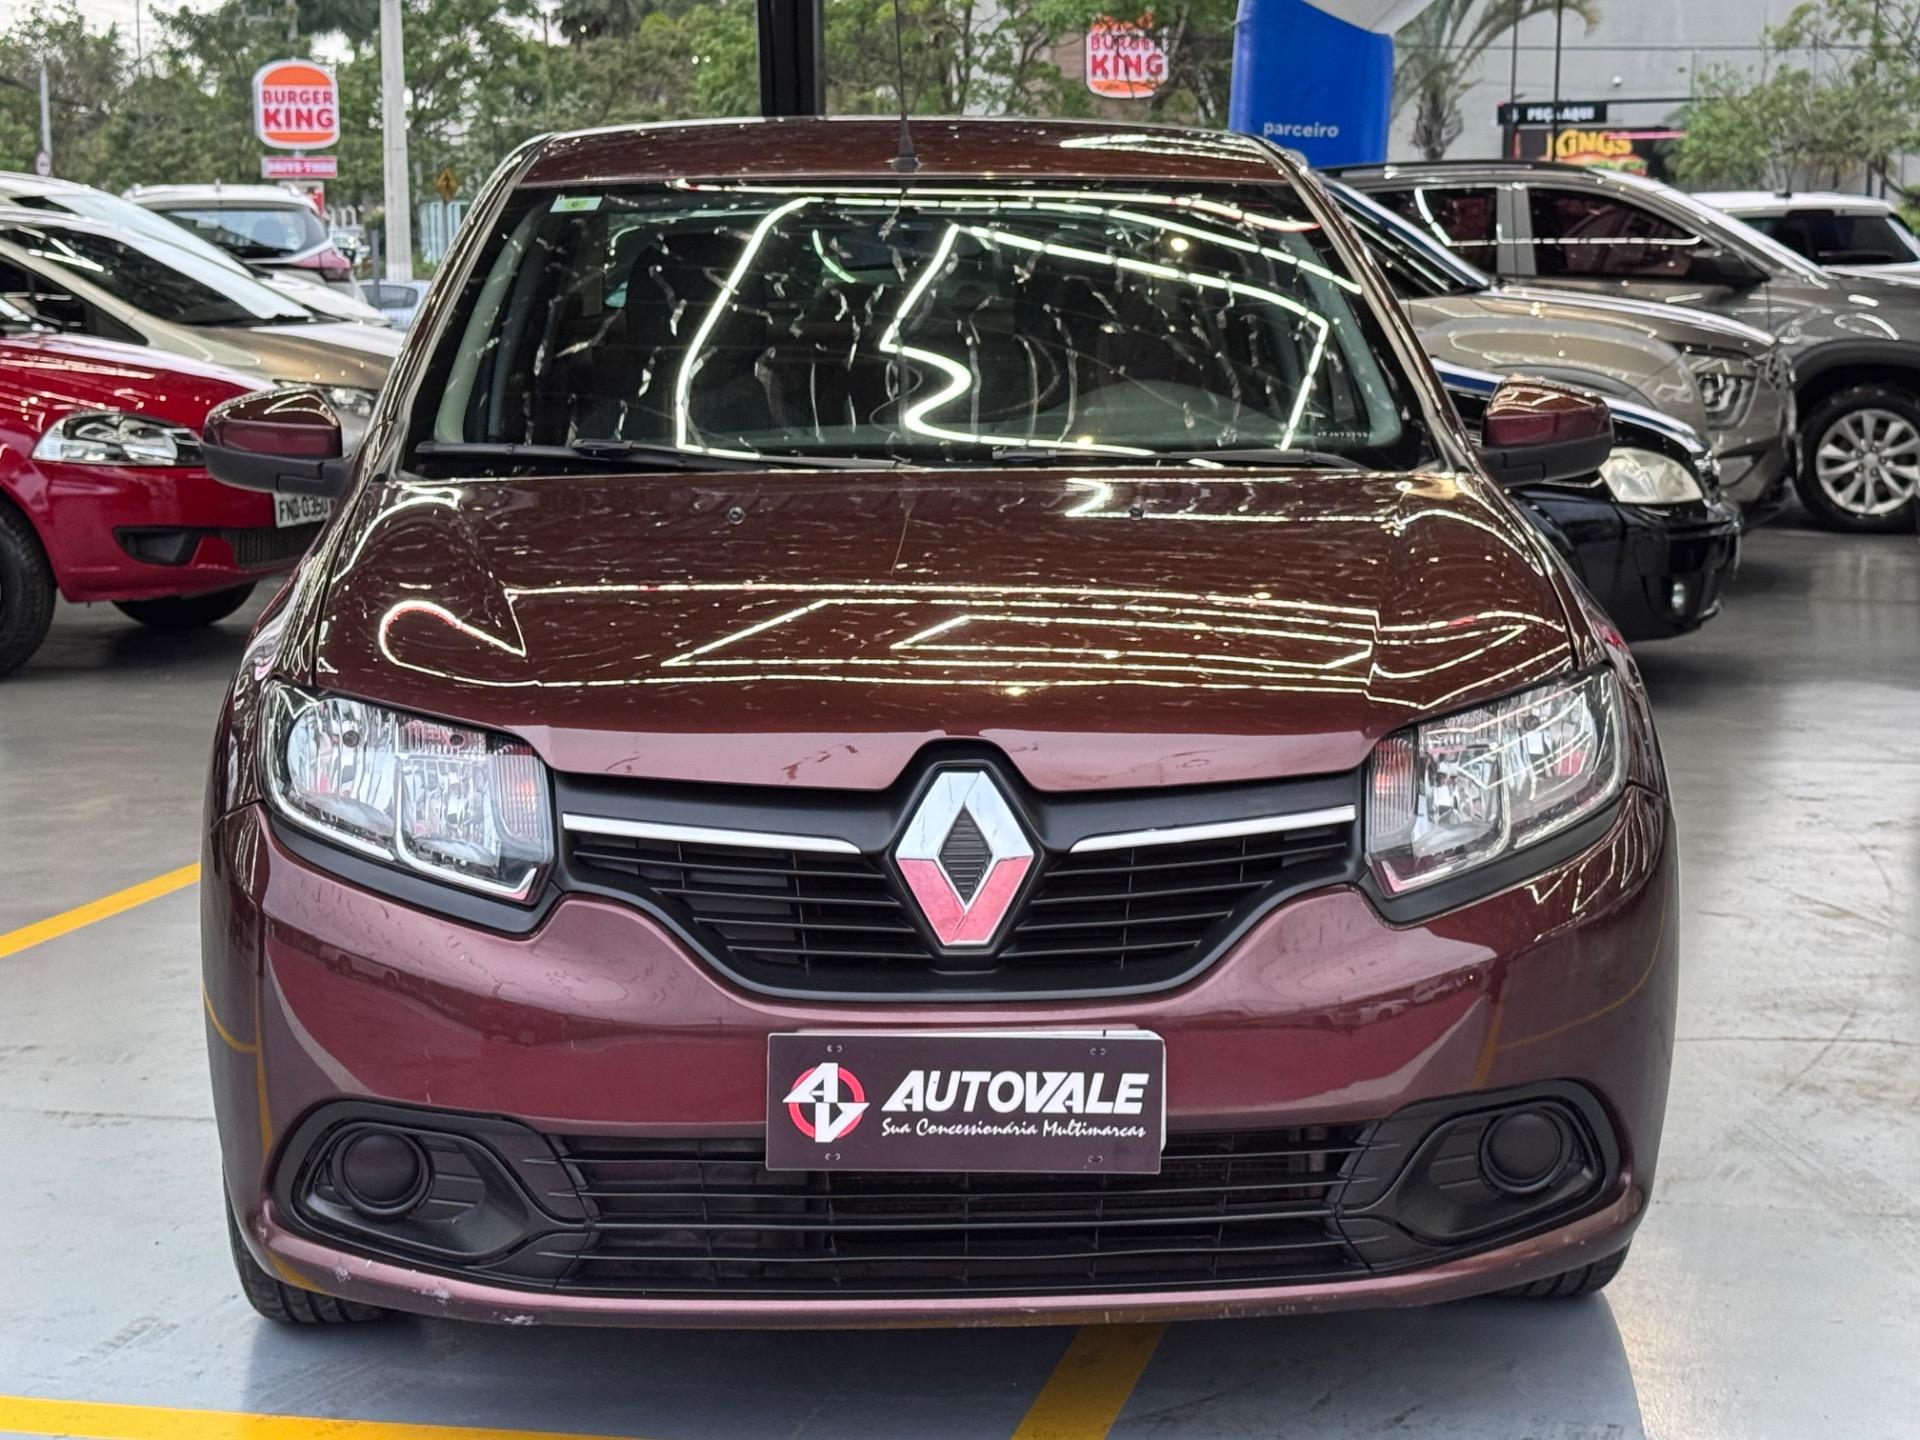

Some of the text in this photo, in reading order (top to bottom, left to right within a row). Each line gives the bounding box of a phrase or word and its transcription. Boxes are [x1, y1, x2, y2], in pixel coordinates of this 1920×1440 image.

[1091, 53, 1163, 78] KING
[262, 90, 334, 105] BURGER
[263, 108, 335, 129] KING
[1263, 121, 1340, 138] parceiro
[881, 1070, 1150, 1115] AUTOVALE
[881, 1116, 1147, 1138] Sua Concessionária Multimarcas
